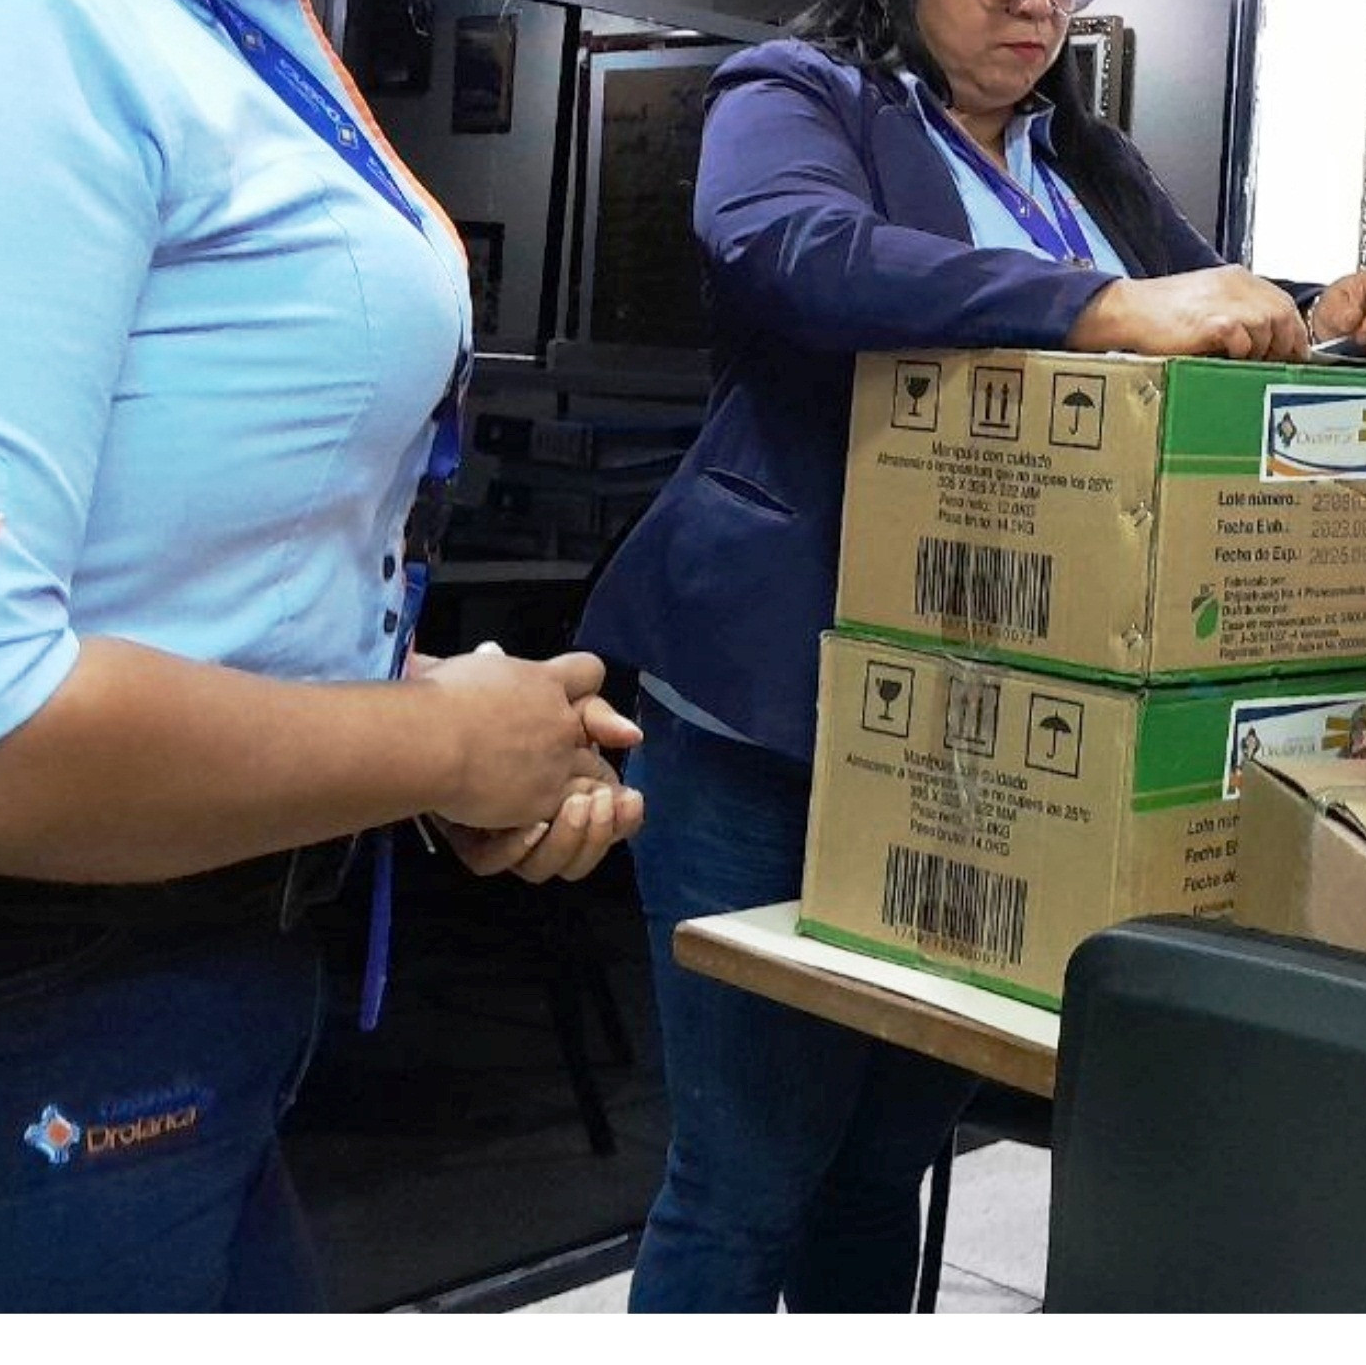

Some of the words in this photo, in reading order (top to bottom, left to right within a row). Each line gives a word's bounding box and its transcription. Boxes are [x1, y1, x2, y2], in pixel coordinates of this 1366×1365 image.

[1218, 490, 1246, 506] Lote
[1216, 518, 1254, 536] Fecha
[1214, 545, 1253, 563] Fecha
[1254, 545, 1271, 561] de
[1184, 842, 1222, 865] Fecha
